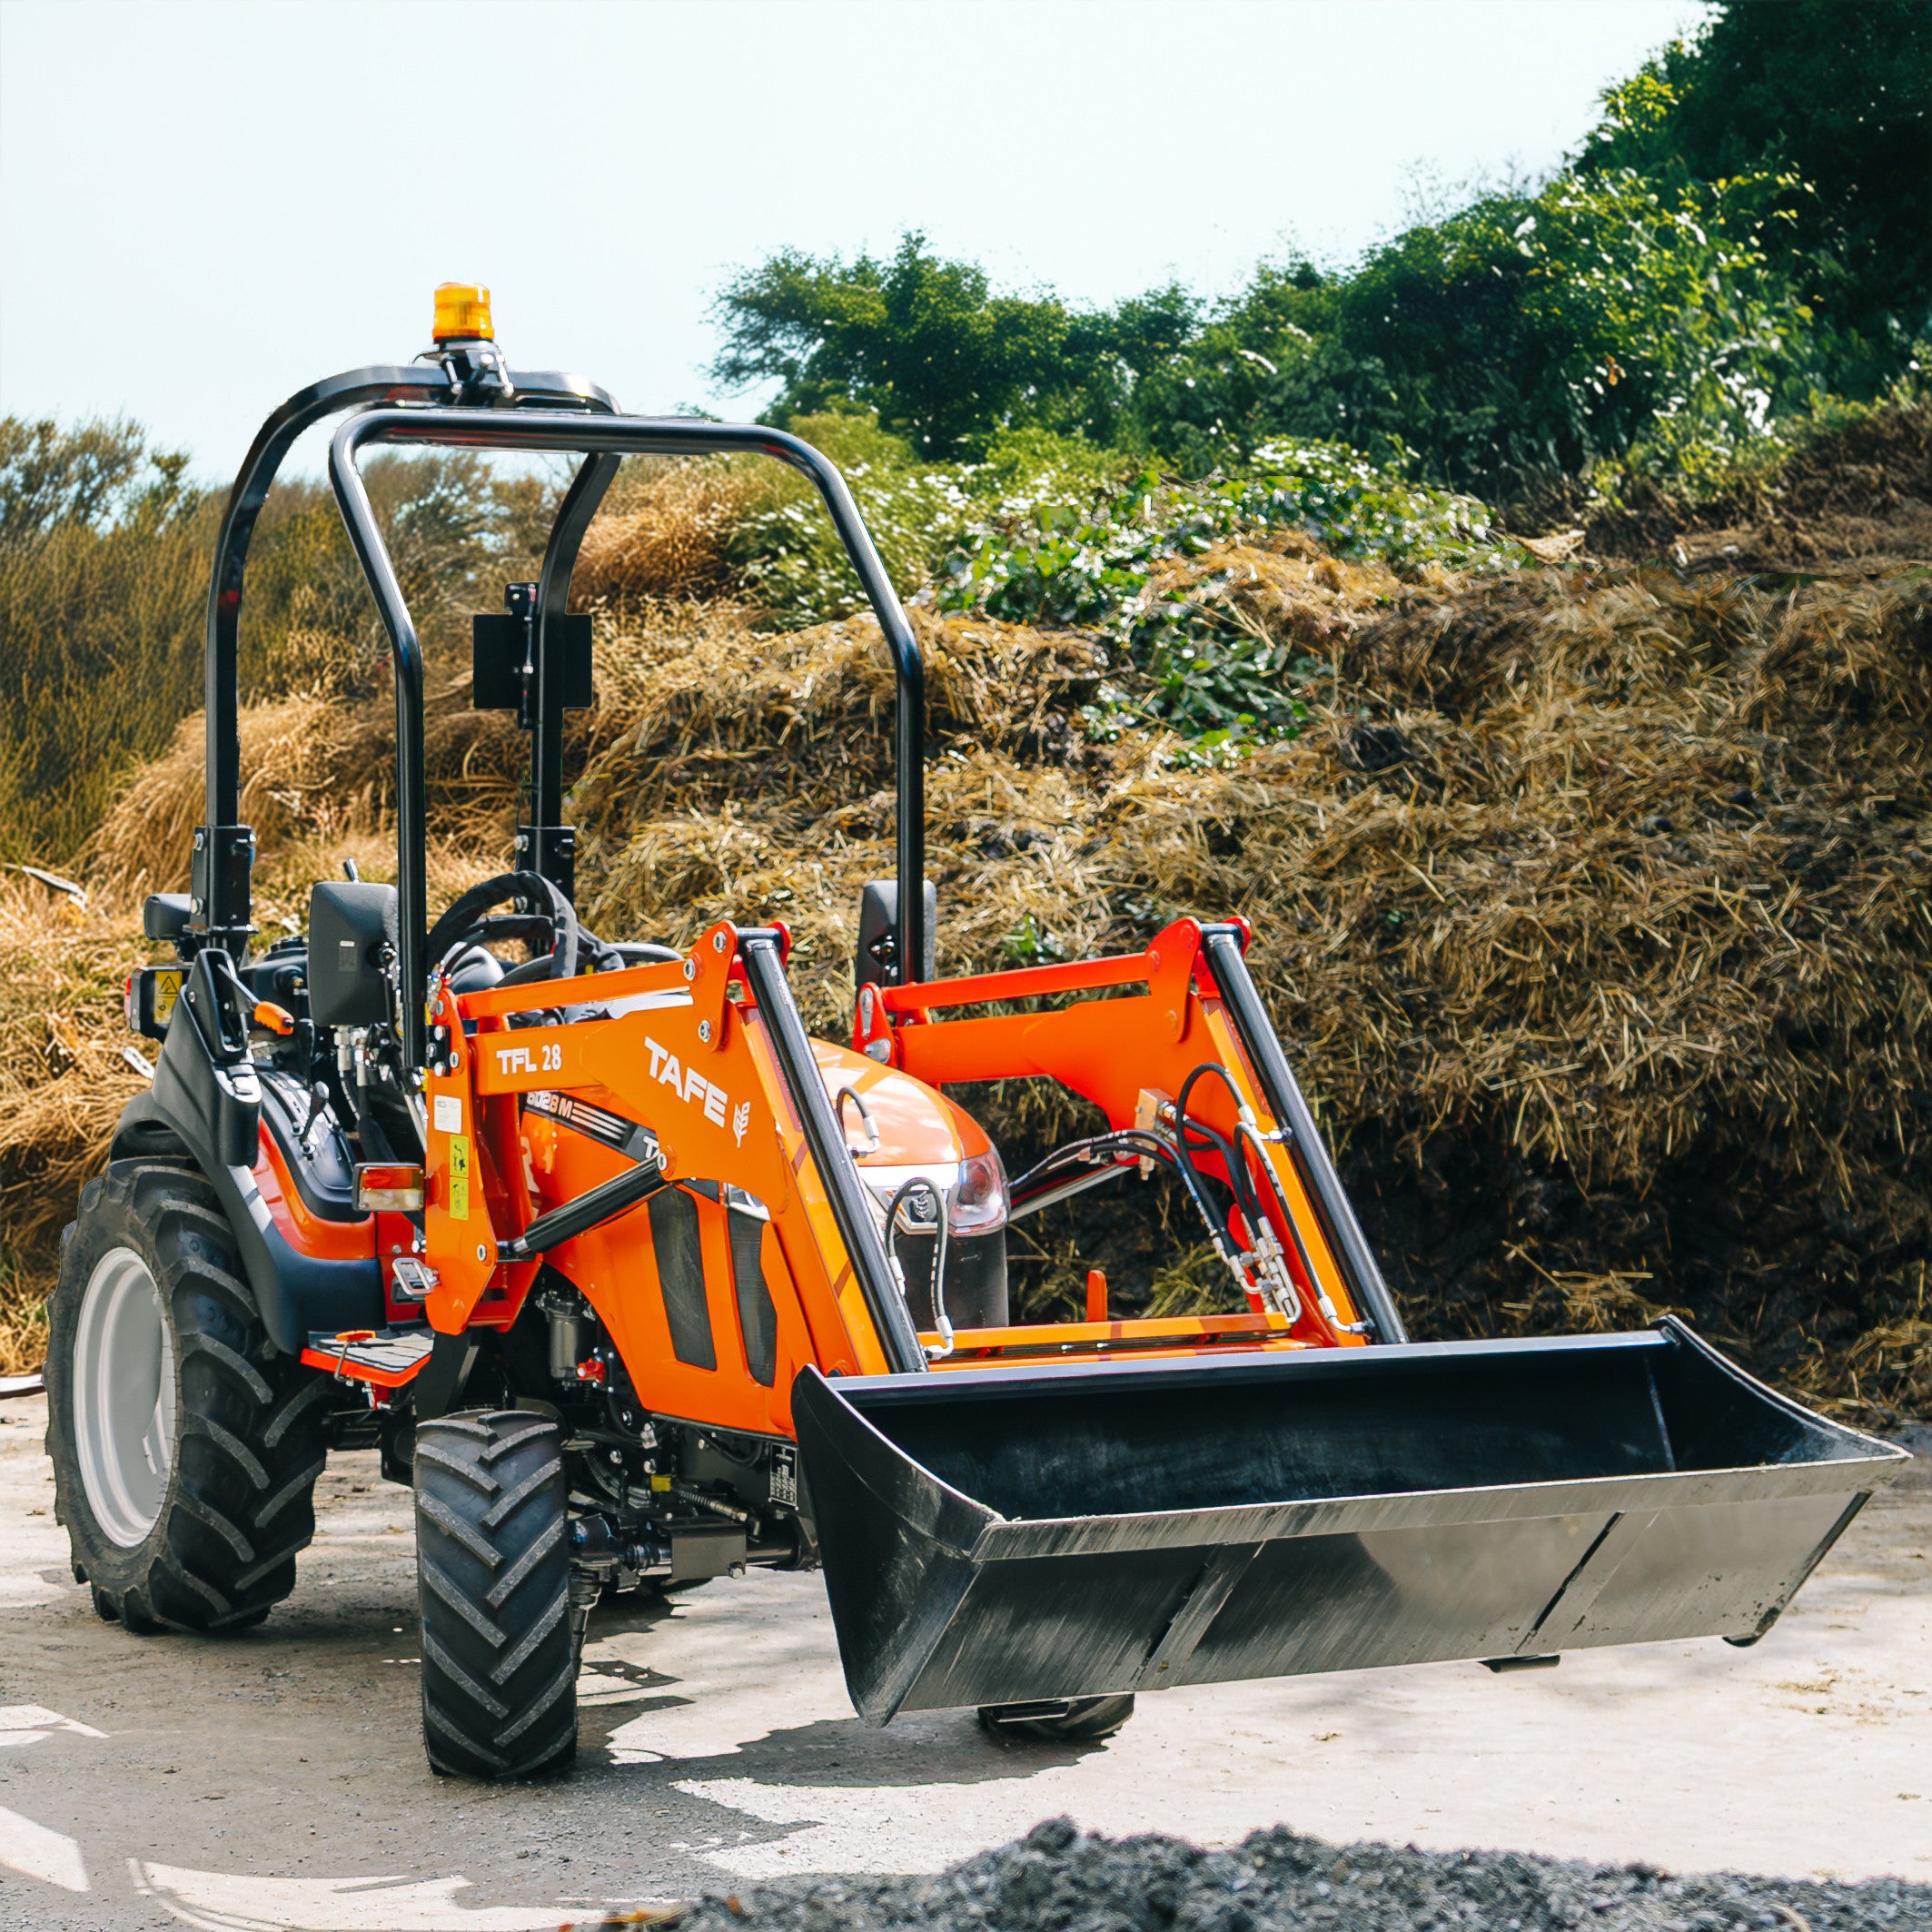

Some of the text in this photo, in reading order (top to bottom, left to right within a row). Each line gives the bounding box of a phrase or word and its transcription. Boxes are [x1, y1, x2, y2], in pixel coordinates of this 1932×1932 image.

[496, 1044, 561, 1075] TFL 28
[644, 1036, 728, 1128] TAFE
